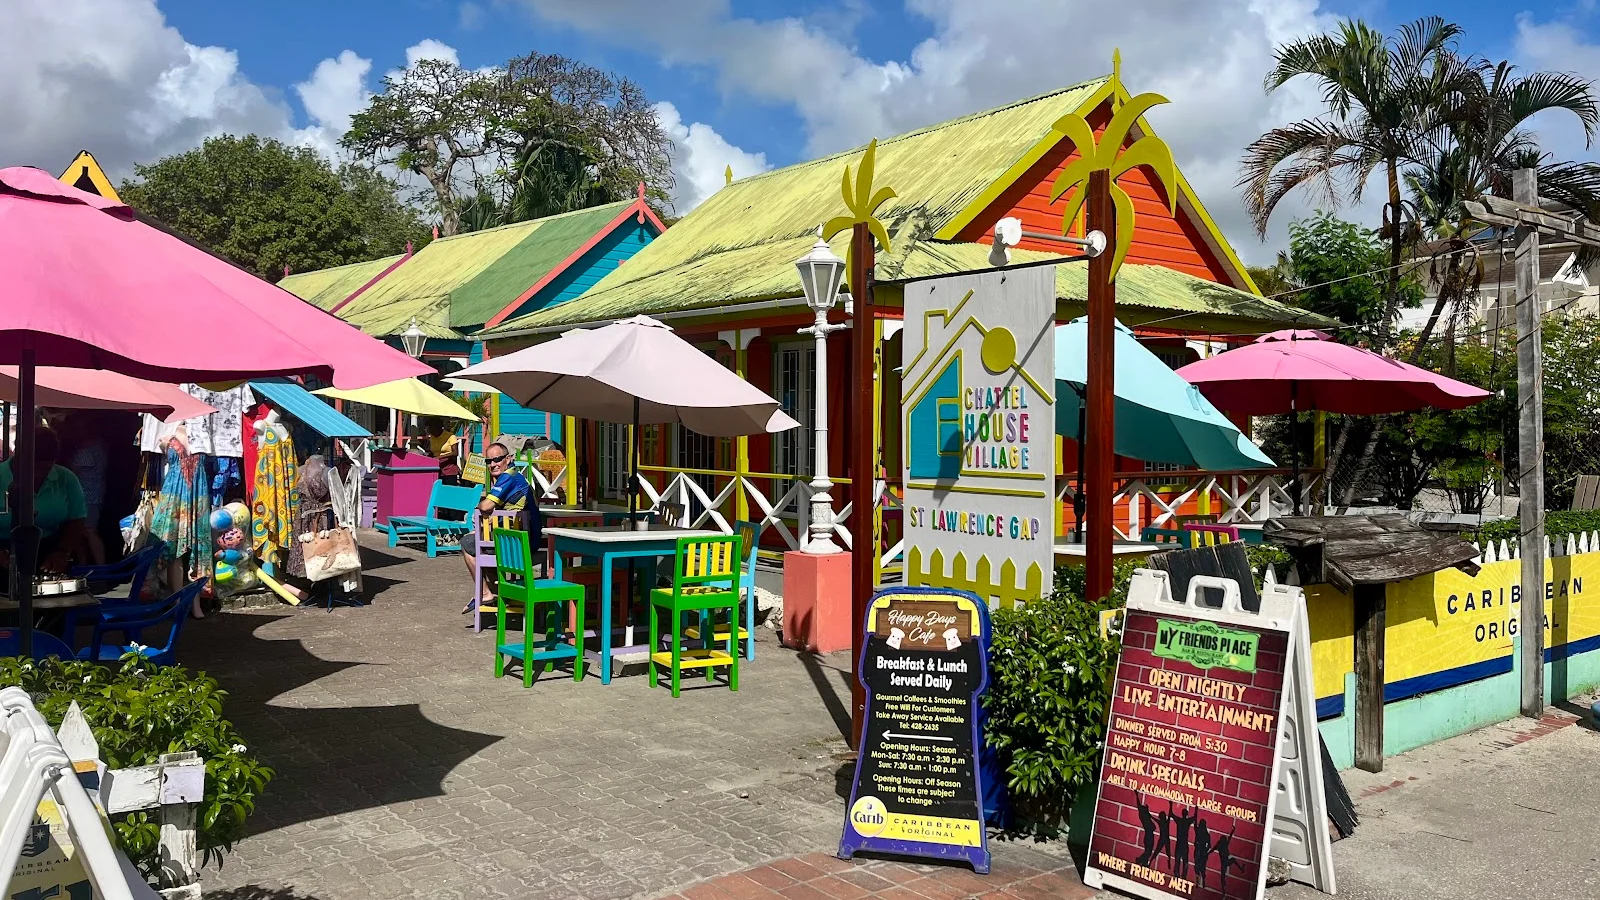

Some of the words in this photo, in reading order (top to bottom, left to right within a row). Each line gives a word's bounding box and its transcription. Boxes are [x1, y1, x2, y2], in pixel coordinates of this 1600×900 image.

[965, 386, 1028, 410] CHATTEL
[965, 412, 1029, 443] HOUSE
[965, 445, 1029, 469] VILLAGE
[910, 506, 925, 527] ST
[932, 509, 1003, 538] LAWRENCE
[1010, 516, 1040, 541] GAP
[1447, 577, 1582, 614] CARIBEAN
[888, 609, 924, 627] Happy
[924, 610, 957, 628] Days
[1475, 612, 1559, 642] ORIGAL
[909, 627, 936, 644] Cafe
[1160, 627, 1178, 650] MY
[1179, 631, 1218, 651] FRIENDS
[1220, 637, 1252, 657] PLACE
[877, 656, 924, 671] Breakfast
[927, 658, 935, 671] &
[937, 658, 967, 673] Lunch
[890, 672, 923, 687] Served
[925, 673, 952, 691] Daily
[1149, 668, 1181, 690] OPEN
[1186, 676, 1247, 702] NIGHTLY
[875, 693, 902, 701] Gourmet
[903, 695, 927, 703] Coffees
[934, 697, 966, 705] Smoothies
[875, 711, 890, 719] Take
[891, 712, 909, 721] Away
[910, 713, 933, 721] Service
[934, 714, 965, 723] Available
[922, 705, 955, 714] Customers
[1123, 686, 1153, 707] LIVE
[1158, 691, 1274, 733] ENTERTAINMENT
[911, 722, 939, 731] 428-2635
[1115, 717, 1145, 735] DINNER
[1147, 725, 1177, 742] SERVED
[1179, 733, 1202, 748] FROM
[1205, 737, 1228, 753] 5:30
[880, 742, 909, 752] Opening
[910, 744, 931, 752] Hours:
[932, 745, 957, 754] Season
[1113, 734, 1141, 752] HAPPY
[1143, 741, 1166, 757] HOUR
[1169, 747, 1186, 761] 7-8
[871, 751, 901, 759] Mon-Sat:
[902, 752, 915, 760] 7:30
[917, 754, 930, 762] a.m
[936, 755, 951, 763] 2:30
[951, 757, 965, 765] p.m
[878, 760, 892, 768] Sun:
[893, 761, 908, 770] 7:30
[928, 764, 942, 773] 1:00
[943, 766, 957, 774] p.m
[872, 774, 902, 785] Opening
[902, 776, 923, 785] Hours:
[924, 777, 936, 786] Off
[936, 779, 961, 788] Season
[1110, 752, 1146, 775] DRINK
[1151, 763, 1205, 792] SPECIALS
[877, 784, 896, 792] These
[897, 785, 915, 794] times
[916, 788, 929, 796] are
[930, 789, 956, 798] subject
[1106, 773, 1126, 788] ABLE
[1128, 778, 1138, 790] TO
[1140, 783, 1194, 805] ACCOMMODATE
[1196, 797, 1223, 813] LARGE
[1225, 804, 1257, 822] GROUPS
[897, 795, 905, 803] to
[906, 796, 933, 806] change
[853, 811, 884, 825] Carib
[893, 818, 971, 831] CARIBBEAN
[907, 827, 955, 838] ORIGINAL
[15, 857, 69, 870] IBBEAN
[1098, 851, 1127, 873] WHERE
[1130, 863, 1165, 886] FRIENDS
[1168, 878, 1195, 895] MEET
